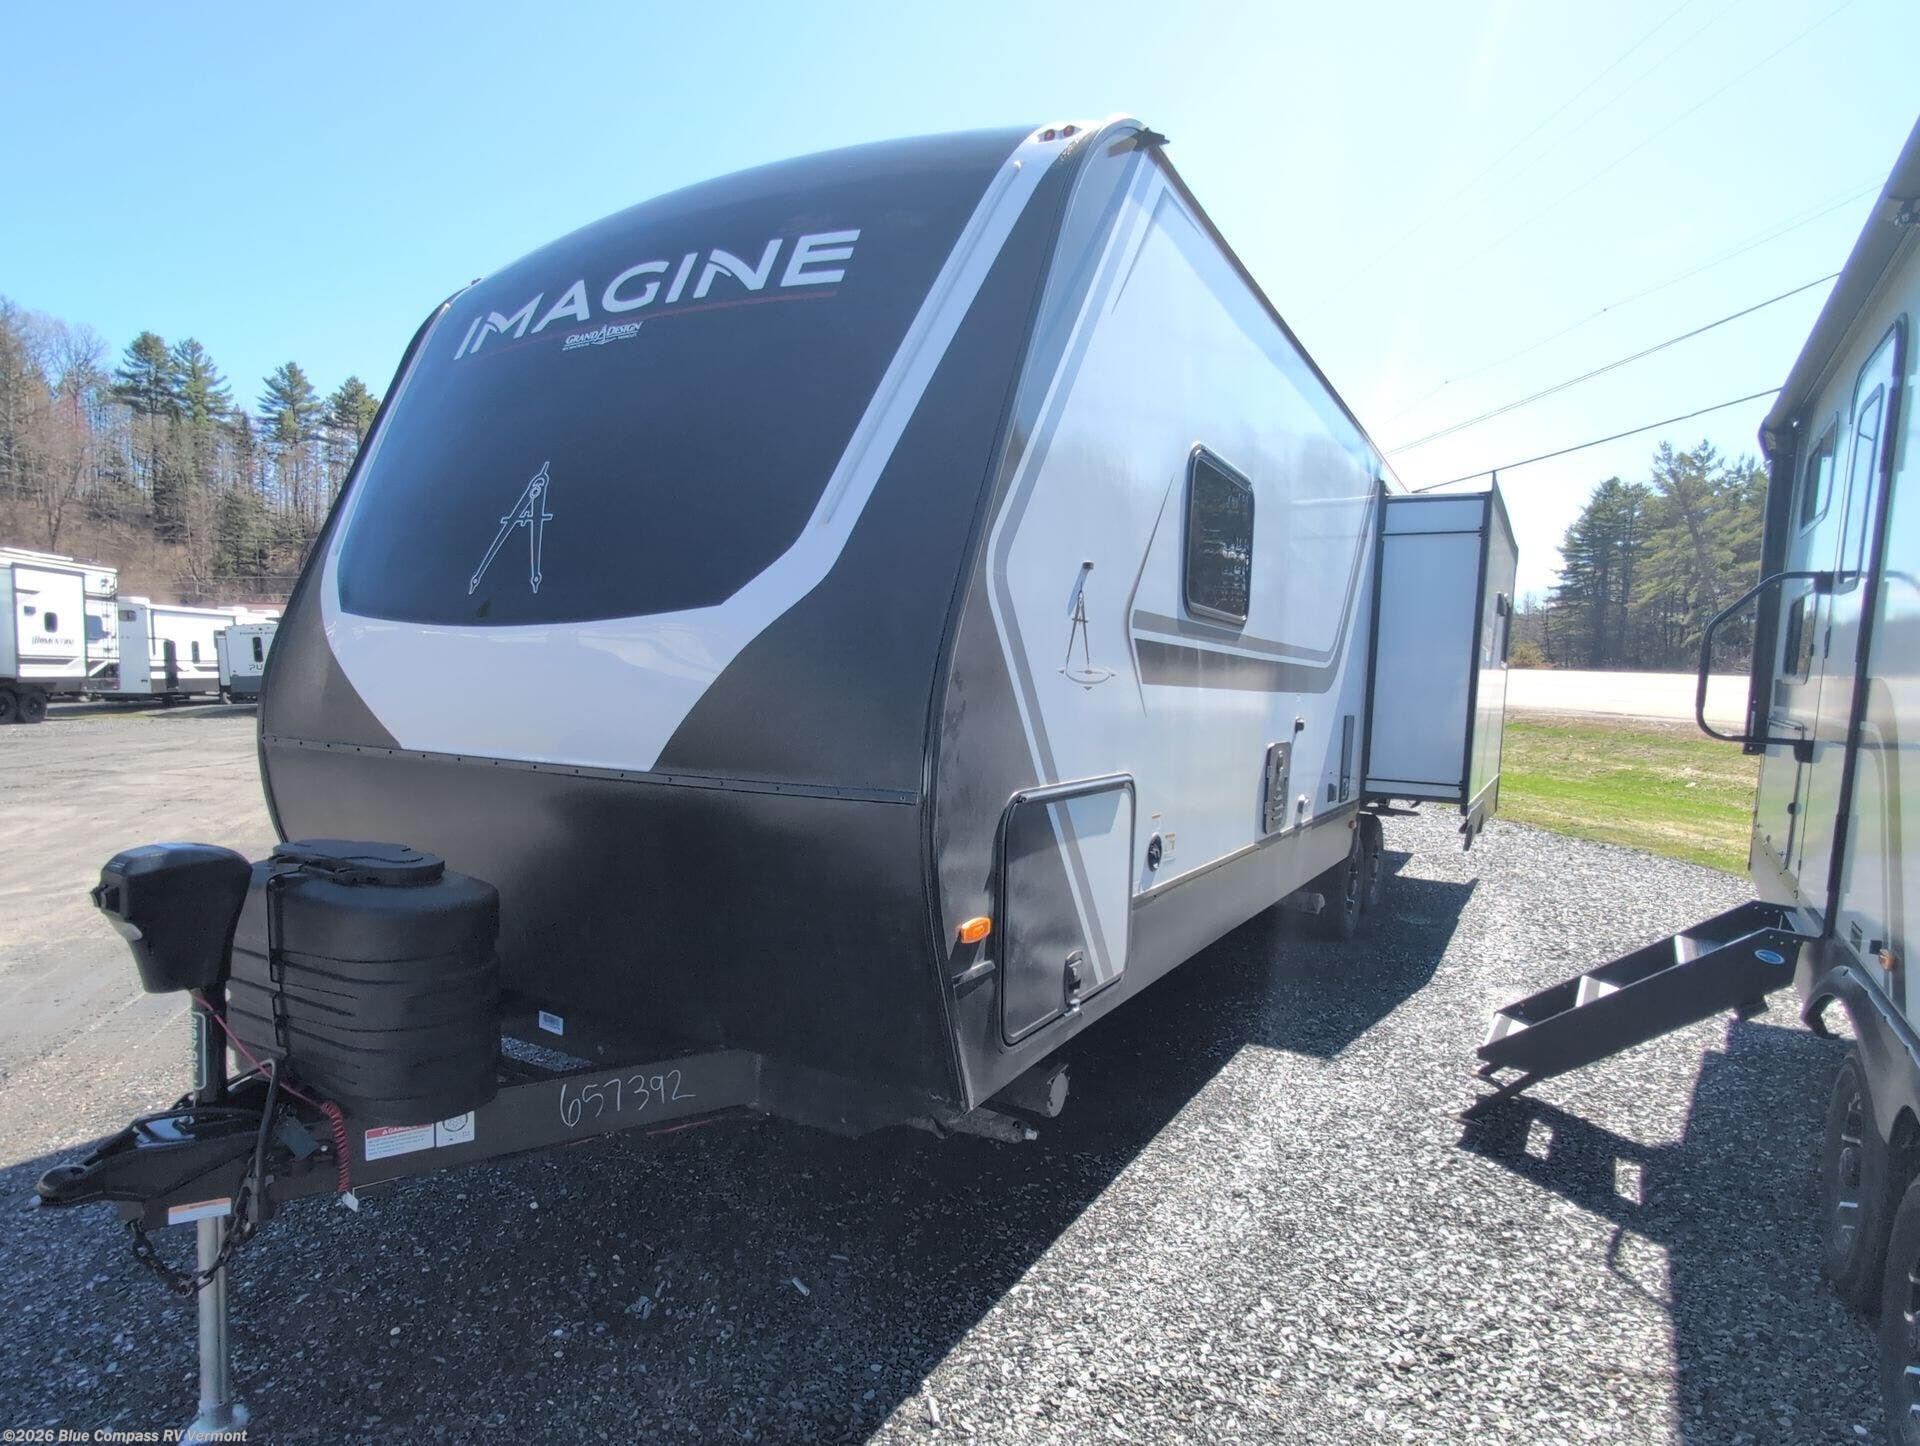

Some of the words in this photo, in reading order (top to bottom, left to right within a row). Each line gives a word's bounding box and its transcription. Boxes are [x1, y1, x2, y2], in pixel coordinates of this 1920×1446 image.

[453, 229, 861, 360] IMAGINE
[565, 331, 602, 345] GRAND
[606, 321, 643, 336] DESIGN
[559, 1069, 697, 1127] 657392
